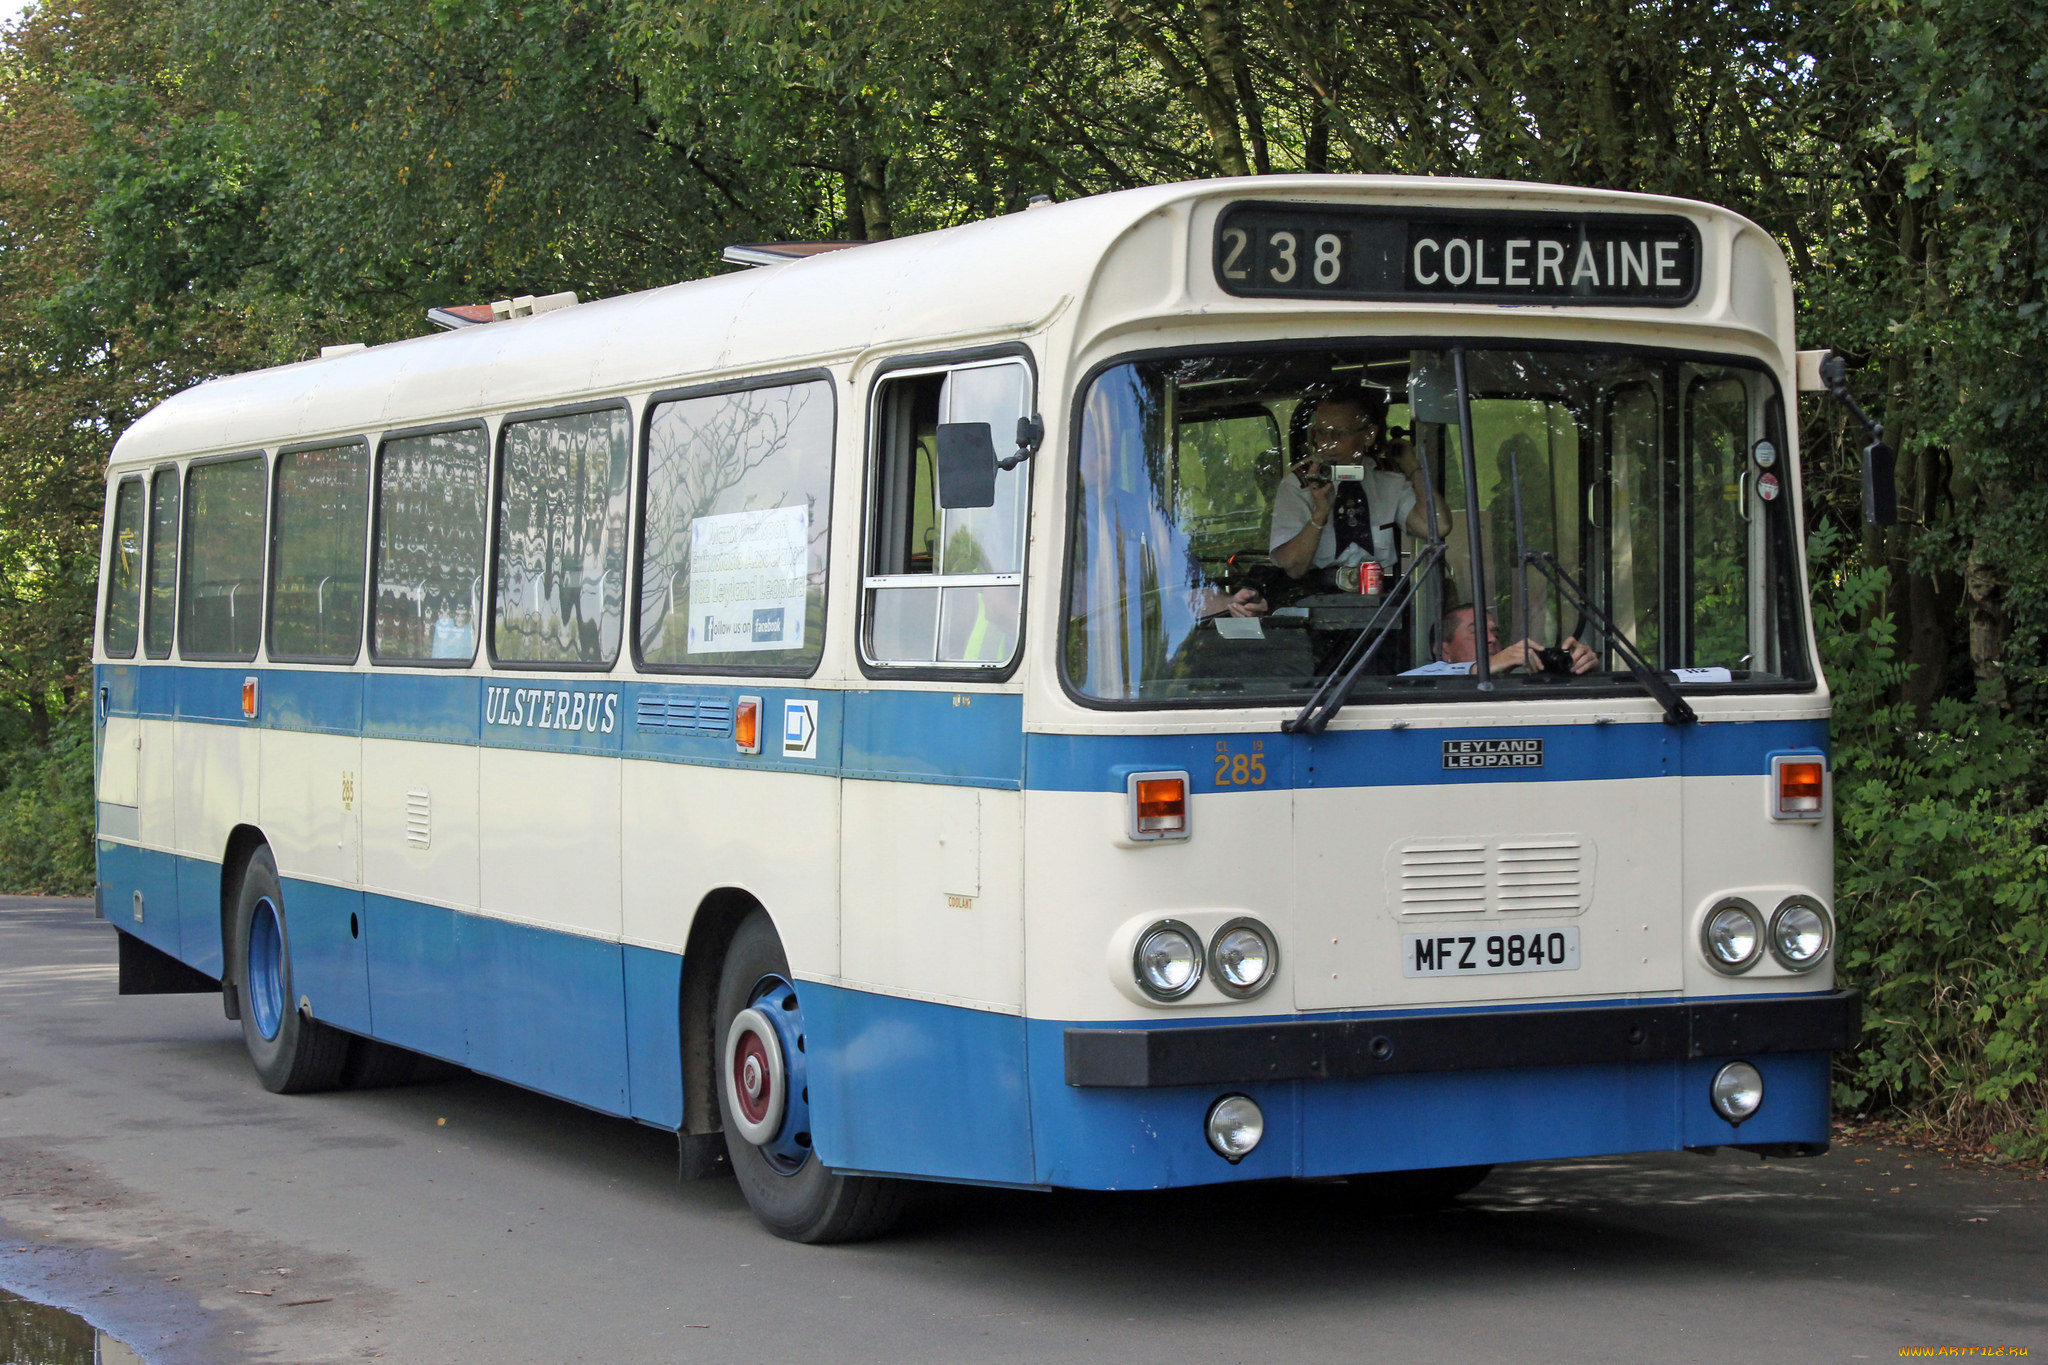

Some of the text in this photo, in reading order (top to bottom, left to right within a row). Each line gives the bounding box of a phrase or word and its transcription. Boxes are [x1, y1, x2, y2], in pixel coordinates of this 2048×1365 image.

[1413, 237, 1682, 287] COLERAINE
[712, 575, 757, 608] Leyland
[759, 575, 806, 605] Leopard
[733, 622, 742, 634] us
[742, 621, 752, 634] on
[755, 617, 781, 633] facebook
[486, 686, 618, 734] ULSTERBUS
[1448, 740, 1538, 753] LEYLAND
[1214, 753, 1267, 785] 285
[1448, 754, 1539, 767] LEOPARD
[342, 779, 354, 802] 285
[948, 896, 972, 909] COOLANT
[1415, 932, 1565, 971] MFZ 9840
